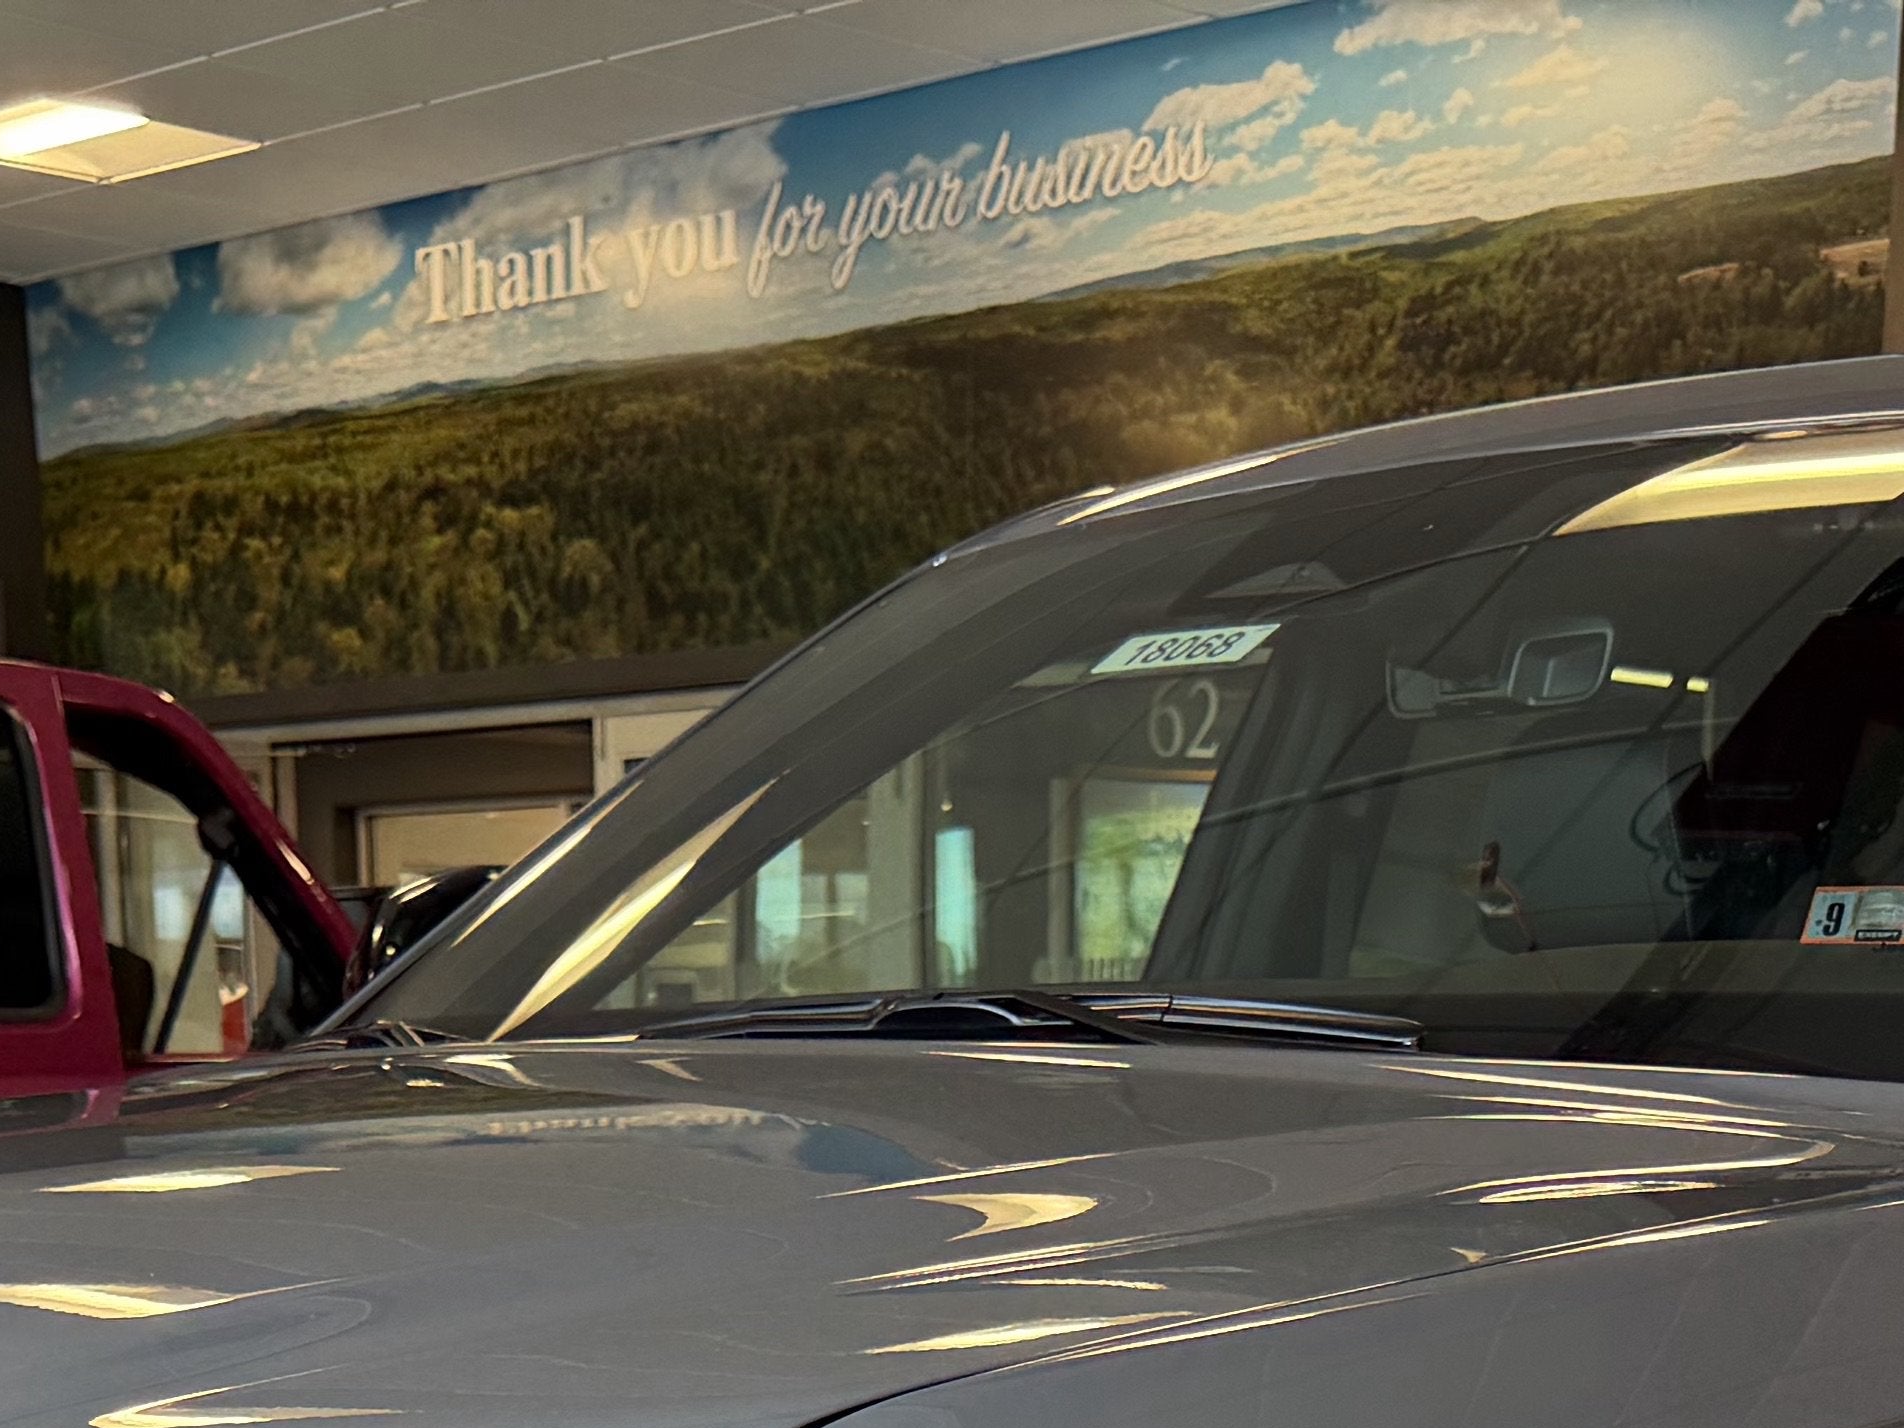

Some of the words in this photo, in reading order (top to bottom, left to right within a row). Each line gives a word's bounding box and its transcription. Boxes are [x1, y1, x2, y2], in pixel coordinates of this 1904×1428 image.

[415, 216, 607, 325] Thank
[620, 207, 740, 308] you
[747, 181, 832, 299] for
[833, 176, 969, 290] your
[976, 121, 1214, 220] business
[1124, 631, 1246, 666] 18068
[1150, 679, 1220, 758] 62
[1822, 902, 1846, 936] 9
